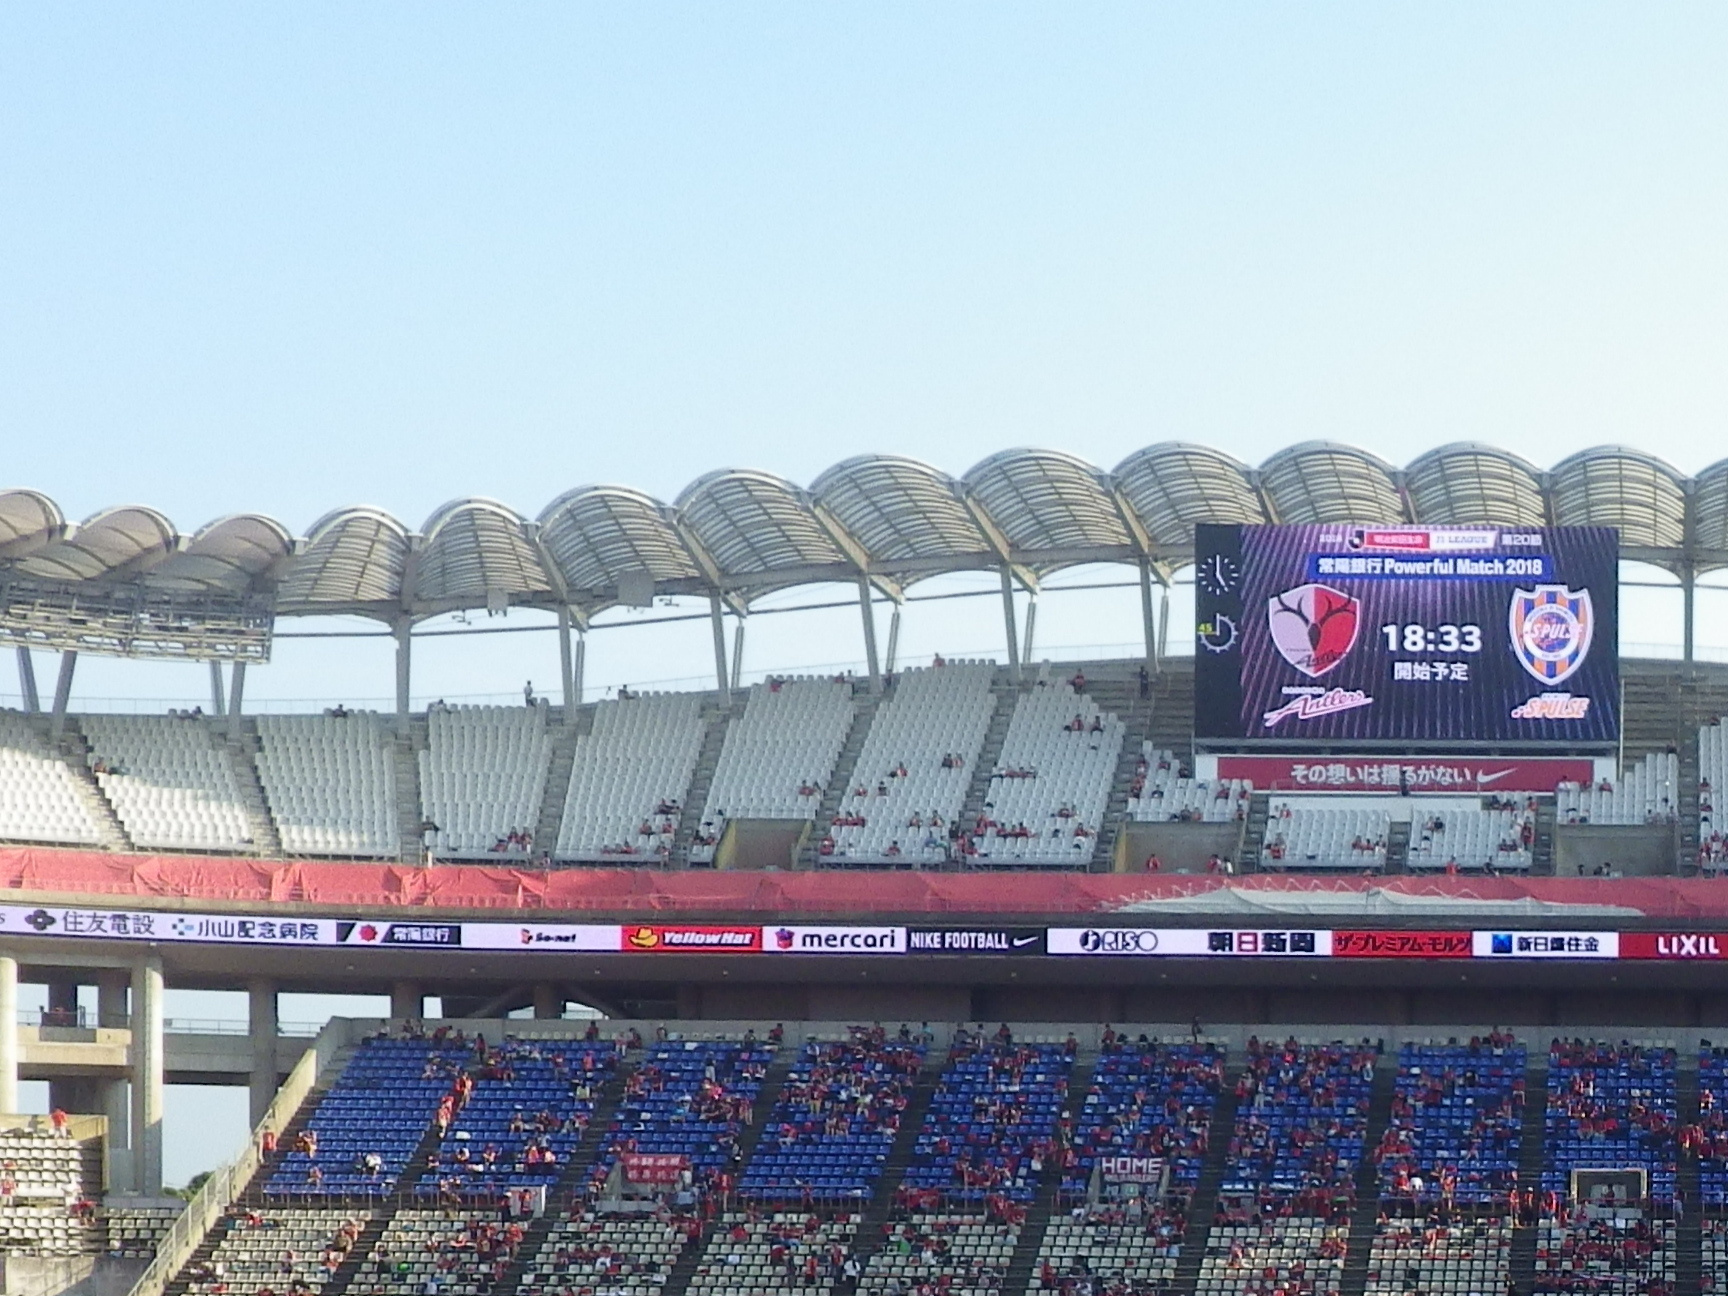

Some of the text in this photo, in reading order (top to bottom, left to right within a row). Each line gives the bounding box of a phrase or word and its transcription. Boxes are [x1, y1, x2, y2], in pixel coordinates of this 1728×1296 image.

[1318, 558, 1543, 575] 常陽銀行 Powerful Match 2018
[1382, 624, 1482, 654] 18:33
[1394, 662, 1469, 682] 開始予定
[62, 910, 156, 935] 住友電設
[198, 918, 318, 940] 小山記念病院
[802, 930, 896, 948] mercari
[910, 932, 1009, 949] NIKE FOOTBALL
[1101, 930, 1158, 951] RISO
[1658, 935, 1720, 956] LIXIL
[1102, 1157, 1162, 1174] HOME
